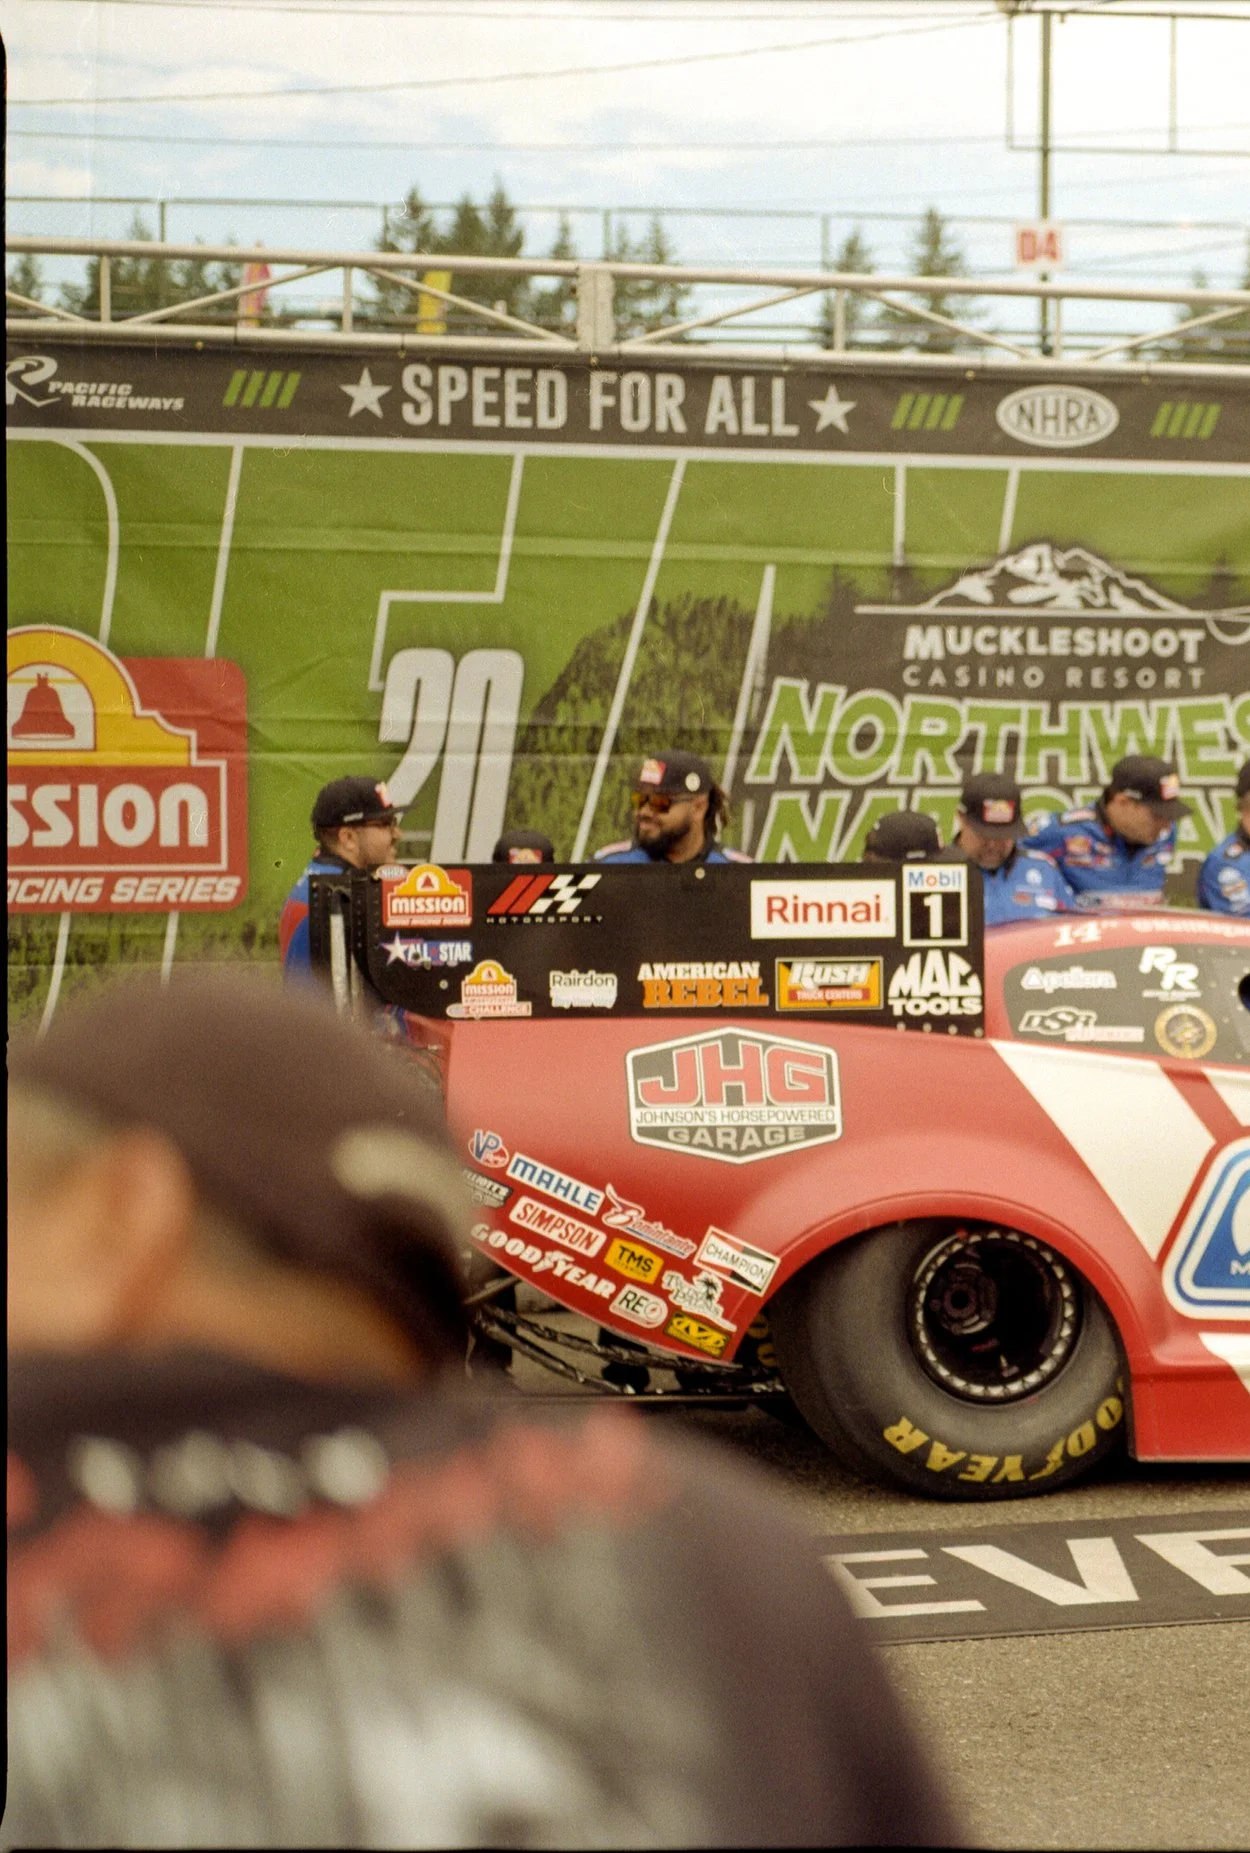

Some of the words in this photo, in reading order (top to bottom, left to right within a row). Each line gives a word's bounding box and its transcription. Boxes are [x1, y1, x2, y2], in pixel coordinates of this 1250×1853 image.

[48, 381, 133, 396] PACIFIC
[71, 394, 185, 411] RACEWAYS
[401, 364, 568, 429] SPEED
[589, 371, 687, 434] FOR
[705, 376, 799, 437] ALL
[1014, 396, 1100, 438] NHRA
[903, 624, 1206, 663] MUCKLESHOOT
[903, 666, 1045, 689] CASINO
[1066, 666, 1206, 690] RESORT
[377, 648, 524, 864] 20
[111, 876, 241, 903] SERIES
[908, 871, 962, 888] Mobil
[766, 895, 881, 924] Rinnai
[923, 893, 943, 939] 1
[408, 942, 431, 962] ALL
[439, 942, 472, 961] STAR
[551, 972, 615, 987] Rairdon
[637, 961, 760, 982] AMERICAN
[889, 949, 983, 998] MAC
[643, 978, 769, 1008] REBEL
[888, 997, 983, 1016] TOOLS
[637, 1039, 830, 1107] JHG
[636, 1109, 717, 1125] JOHNSON'S
[721, 1107, 836, 1123] HORSEPOWERED
[474, 1129, 503, 1160] VP
[667, 1126, 806, 1151] GARAGE
[510, 1157, 600, 1211] MAHLE
[516, 1202, 599, 1251] SIMPSON
[470, 1223, 617, 1299] GOODYEAR
[619, 1245, 654, 1274] TMS
[706, 1243, 770, 1281] CHAMPION
